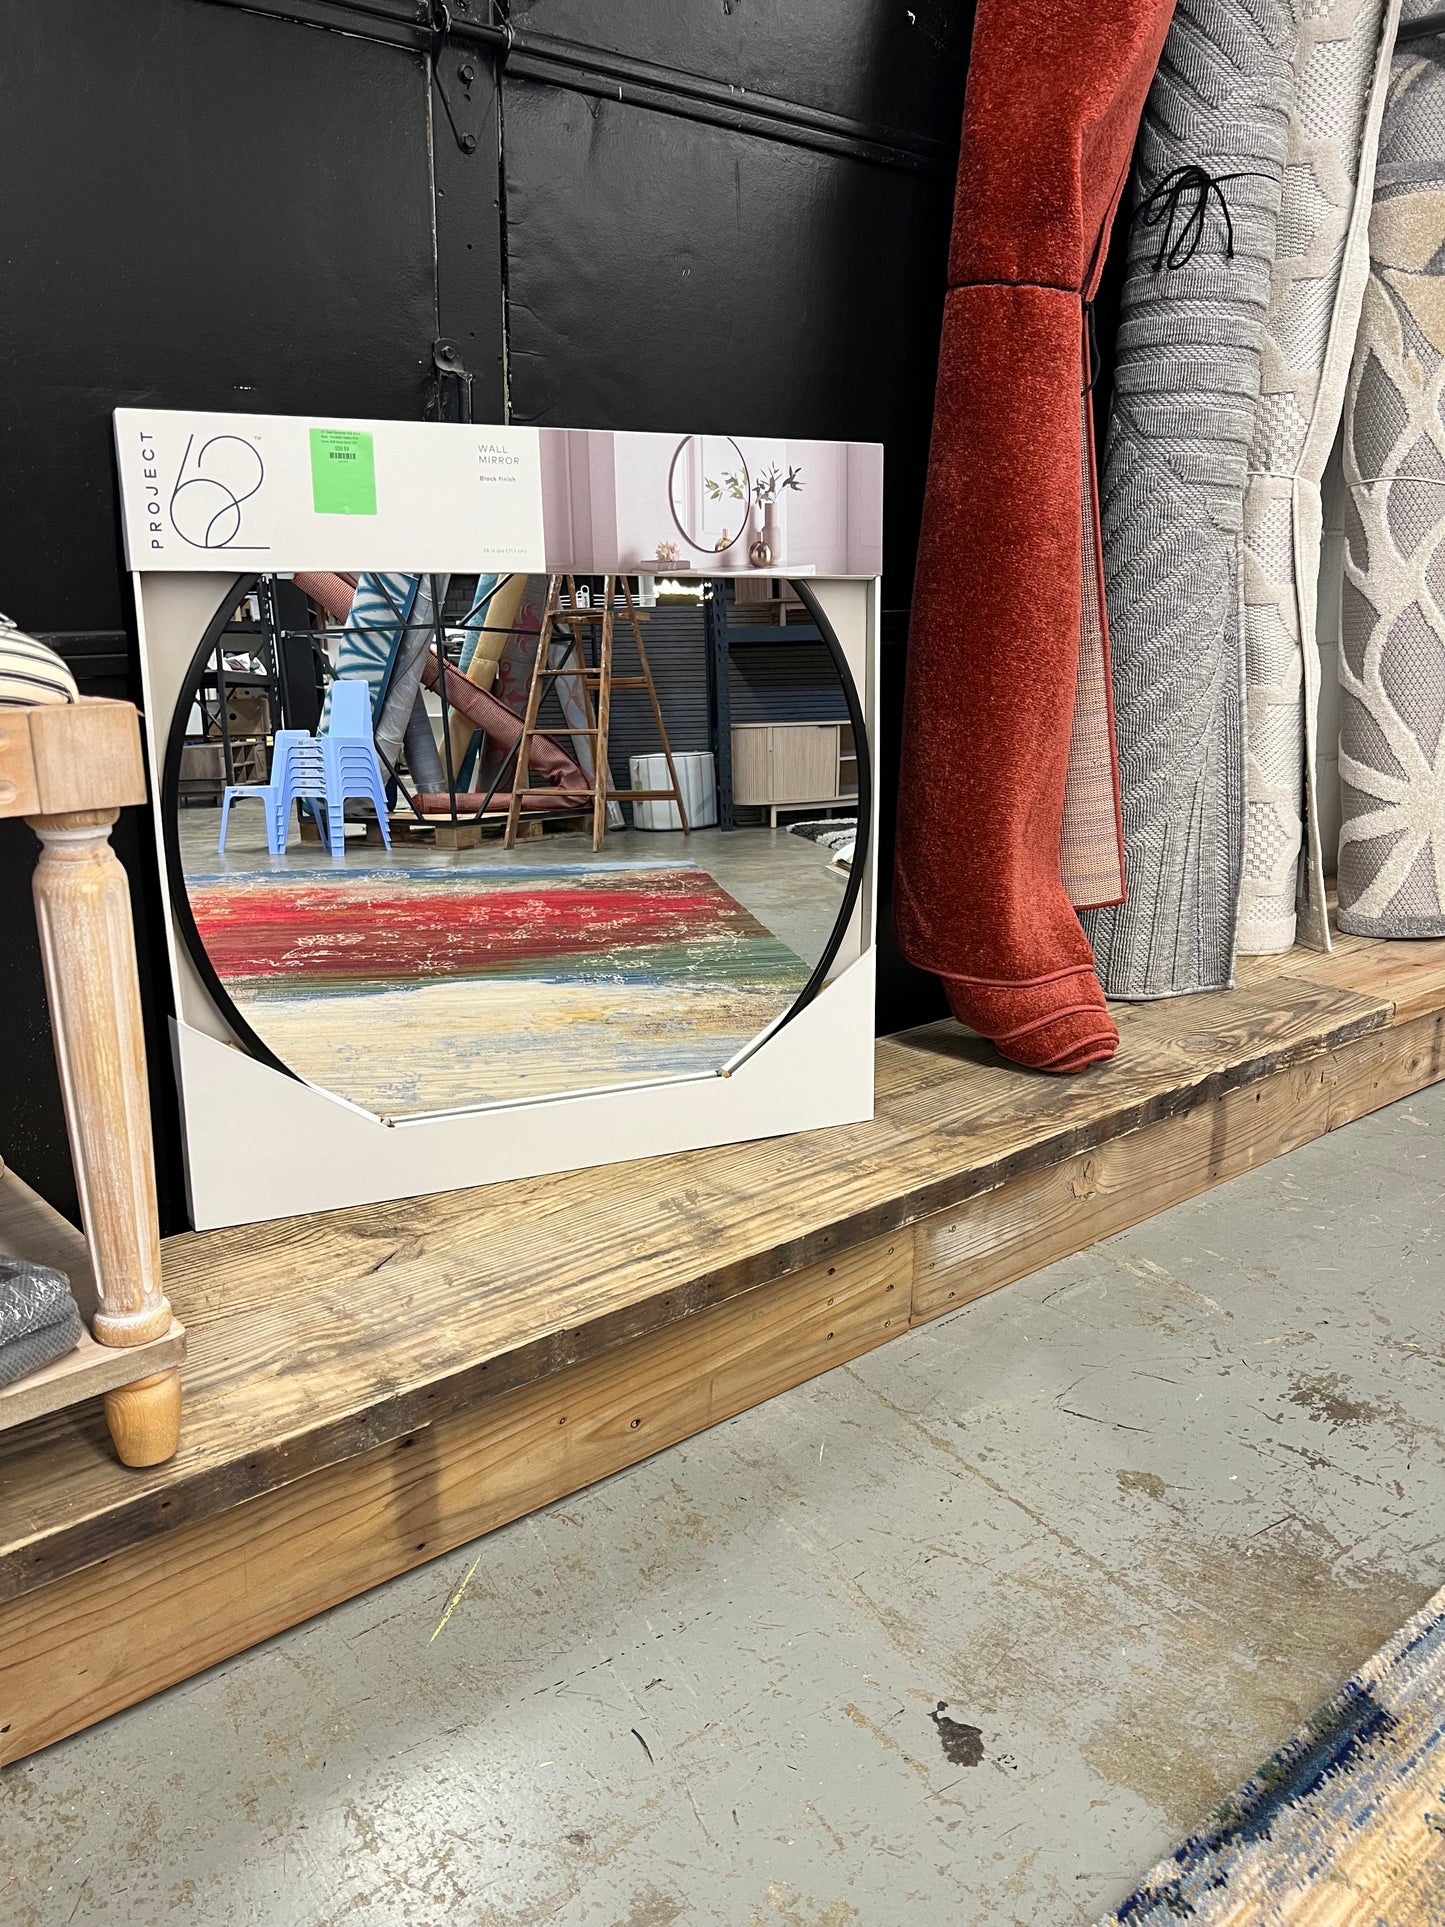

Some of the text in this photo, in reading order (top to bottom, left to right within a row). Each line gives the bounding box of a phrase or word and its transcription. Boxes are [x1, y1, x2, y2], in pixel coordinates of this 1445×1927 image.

[477, 444, 509, 454] WALL
[478, 455, 520, 465] MIRROR
[140, 431, 164, 549] PROJECT
